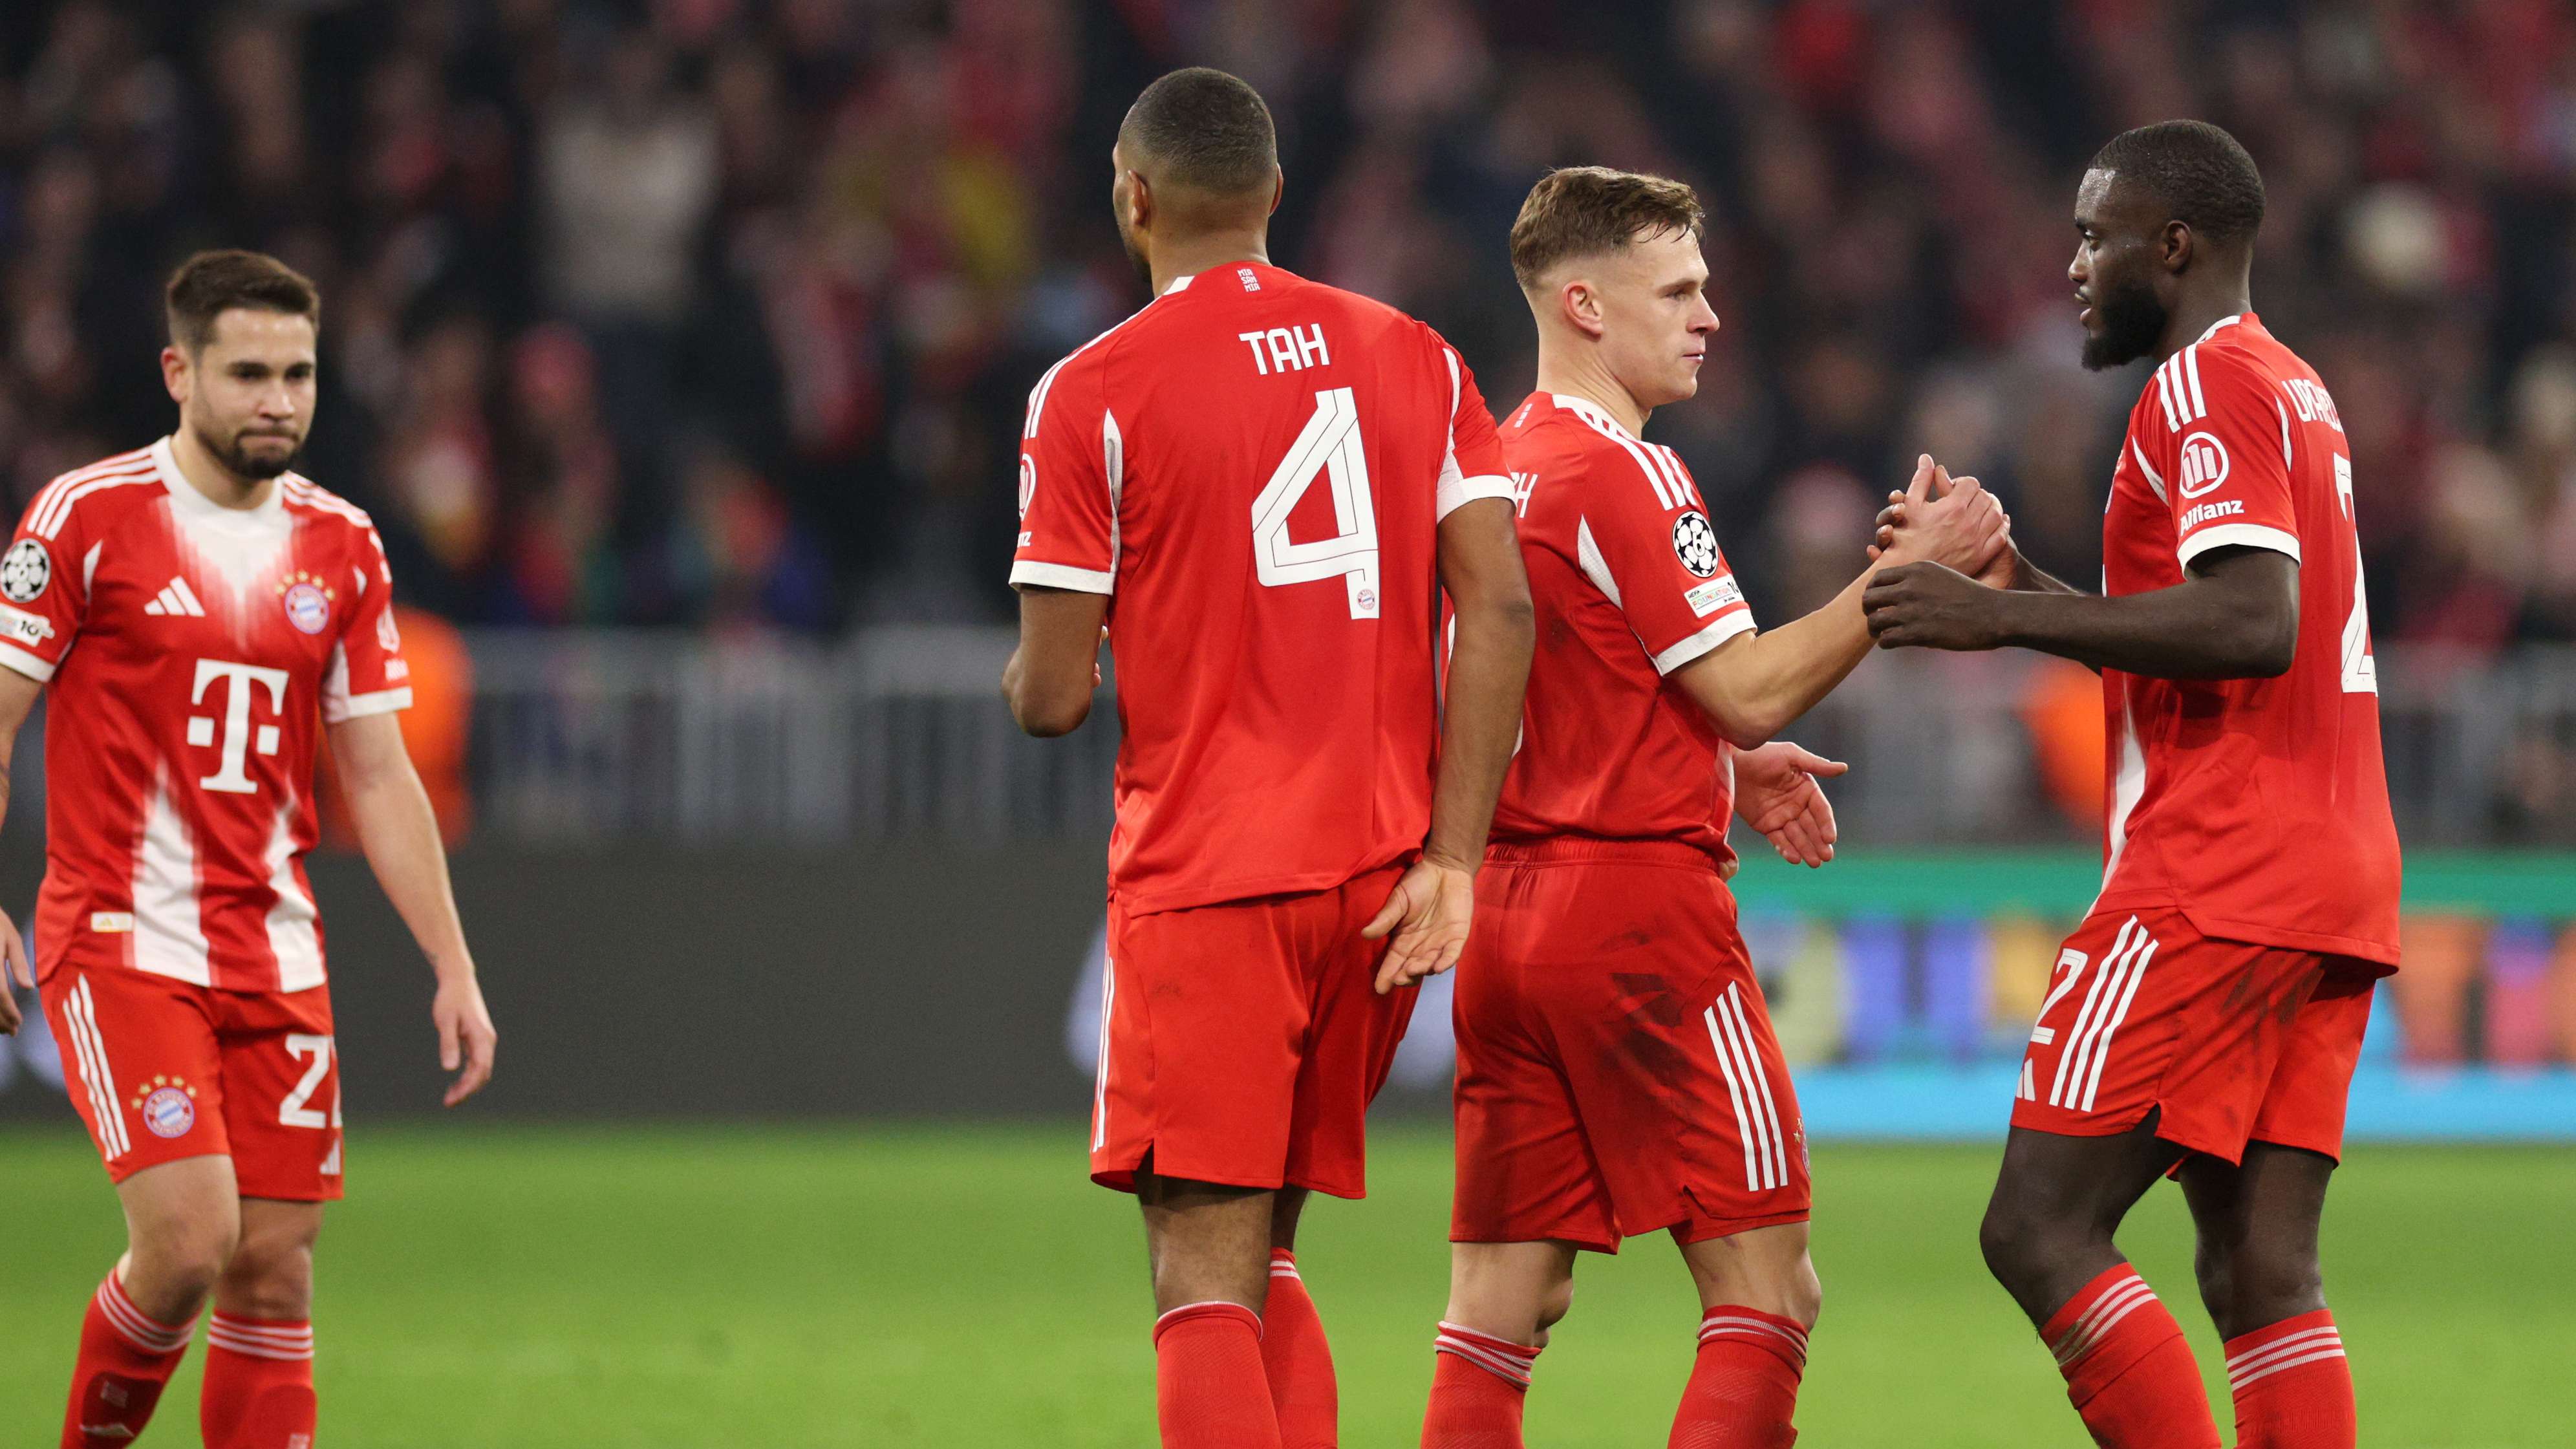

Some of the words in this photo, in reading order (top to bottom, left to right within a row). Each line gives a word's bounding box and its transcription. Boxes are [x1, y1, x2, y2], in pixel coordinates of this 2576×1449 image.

[1237, 268, 1253, 277] MIA
[1245, 283, 1260, 292] MIA
[1238, 323, 1330, 375] TAH
[1251, 386, 1380, 619] 4
[2180, 500, 2245, 537] Allianz
[2030, 948, 2088, 1045] 2
[279, 1033, 343, 1128] 2
